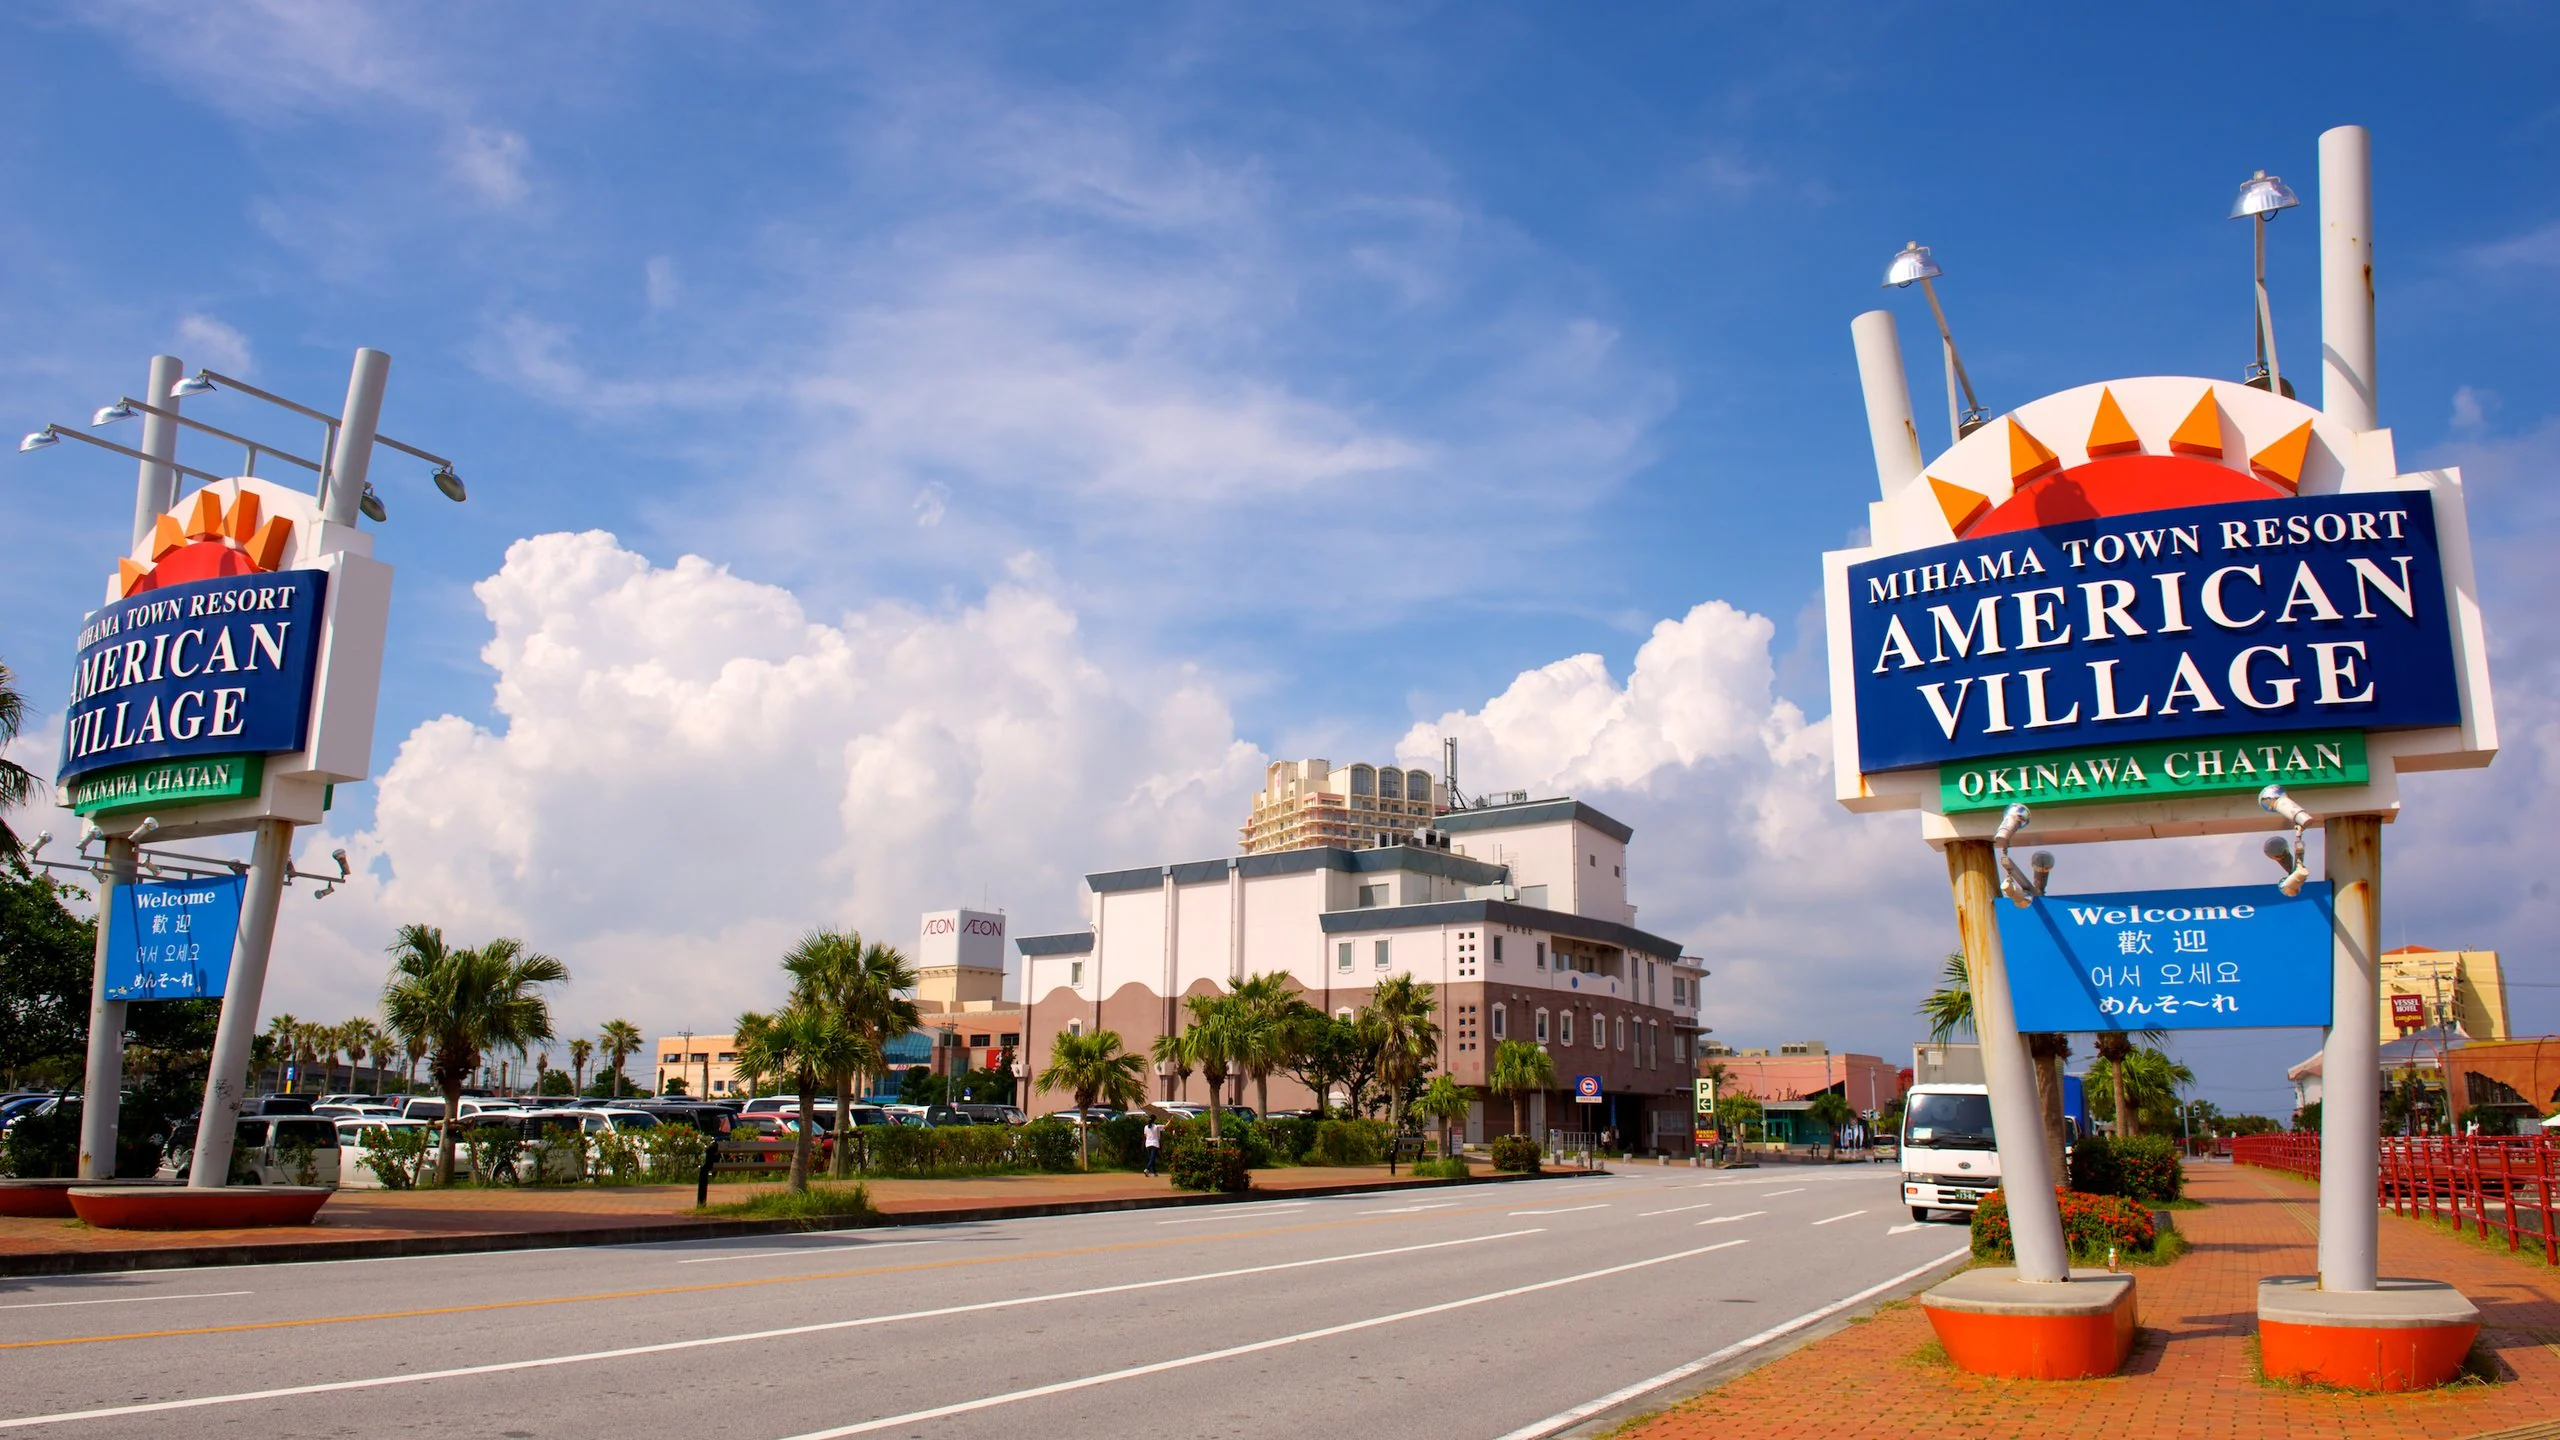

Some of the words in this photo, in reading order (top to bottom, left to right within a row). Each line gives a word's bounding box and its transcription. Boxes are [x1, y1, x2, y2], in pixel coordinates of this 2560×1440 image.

[1867, 546, 2046, 604] MIHAMA
[2062, 524, 2201, 568] TOWN
[2219, 509, 2409, 551] RESORT
[126, 597, 184, 630] TOWN
[189, 586, 296, 617] RESORT
[1873, 555, 2418, 674] AMERICAN
[70, 621, 291, 707] AMERICAN
[1916, 639, 2375, 741] VILLAGE
[68, 687, 248, 762] VILLAGE
[77, 773, 138, 804] OKINAWA
[144, 764, 230, 792] CHATAN
[1958, 755, 2147, 798] OKINAWA
[2163, 742, 2342, 780] CHATAN
[137, 891, 216, 909] Welcome
[2068, 903, 2256, 926] Welcome
[135, 945, 159, 964] 어서
[164, 943, 200, 962] 오세요
[2090, 964, 2142, 989] 어서
[2159, 962, 2242, 987] 오세요
[2393, 998, 2419, 1006] VESSEL
[2396, 1005, 2418, 1013] HOTEL
[1700, 1082, 1709, 1094] P
